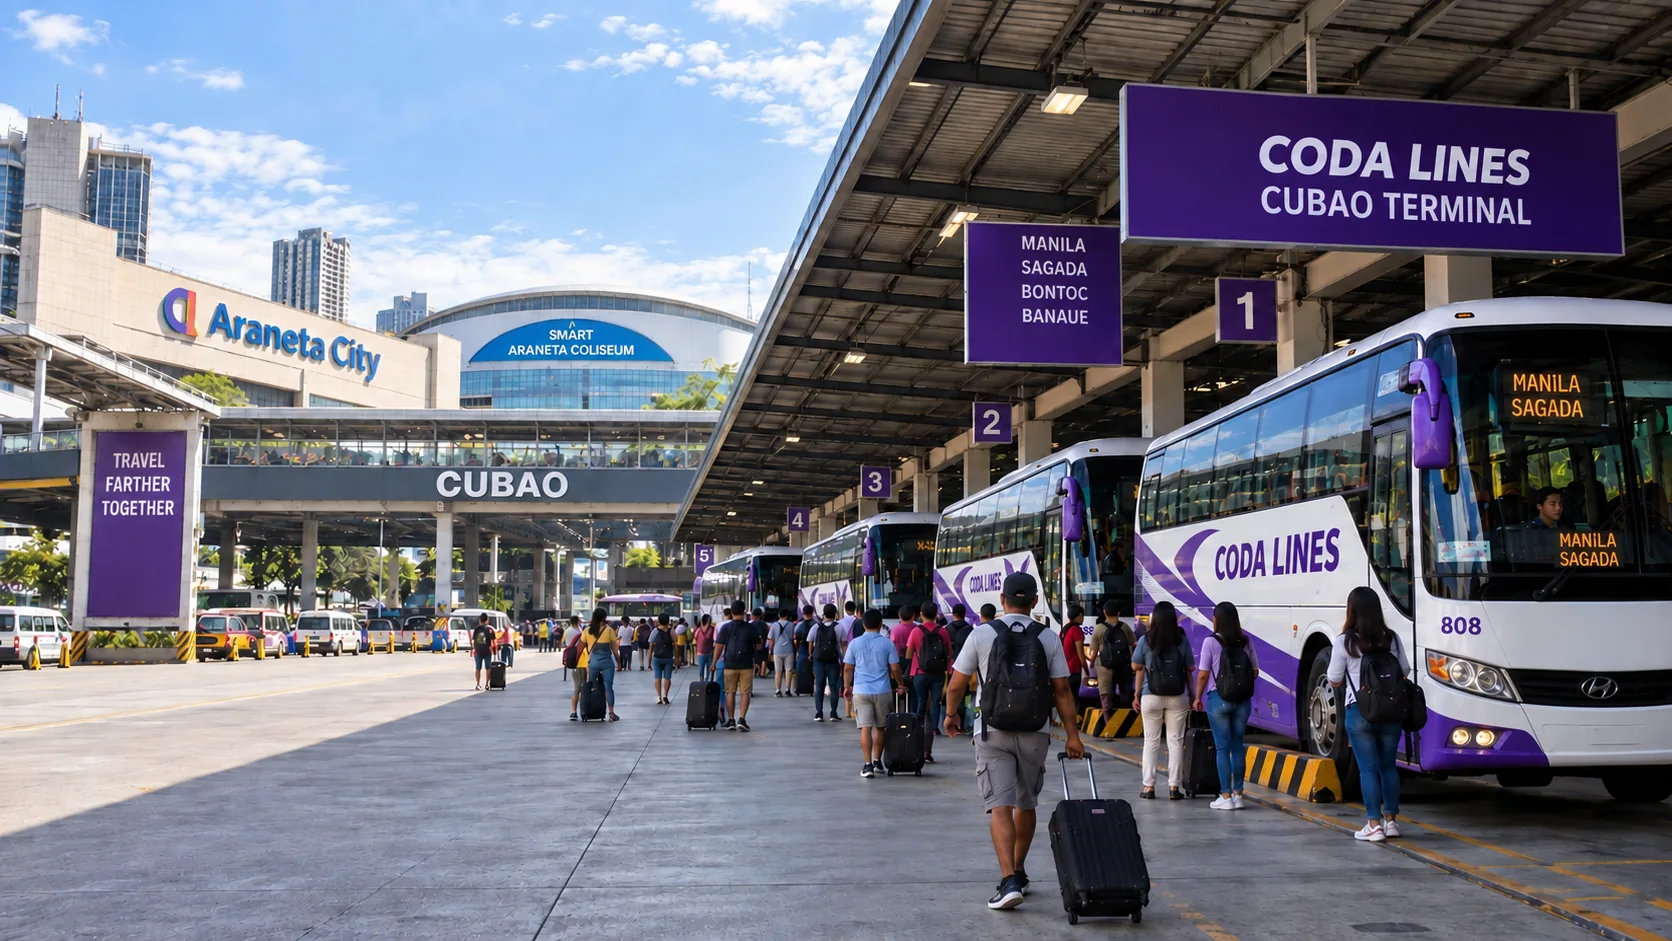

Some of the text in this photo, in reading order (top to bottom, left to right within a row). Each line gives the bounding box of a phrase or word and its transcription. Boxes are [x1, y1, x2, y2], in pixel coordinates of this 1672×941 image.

[1259, 136, 1531, 186] CODA LINES
[1261, 185, 1532, 226] CUBAO TERMINAL
[1021, 235, 1086, 253] MANILA
[1021, 259, 1088, 277] SAGADA
[1021, 284, 1088, 301] BONTOC
[1022, 308, 1089, 325] BANAUE
[1236, 291, 1254, 330] 1
[209, 303, 381, 382] Araneta City
[549, 329, 594, 341] SMART
[508, 344, 635, 356] ARANETA COLISEUM
[1511, 397, 1584, 418] SAGADA
[982, 409, 1001, 435] 2
[113, 452, 165, 469] TRAVEL
[105, 476, 170, 493] FARTHER
[436, 471, 569, 499] CUBAO
[868, 471, 883, 493] 3
[101, 499, 175, 517] TOGETHER
[791, 512, 804, 528] 4
[1215, 528, 1340, 580] CODA LINES
[1559, 551, 1620, 567] SAGADA
[1440, 616, 1482, 636] 808
